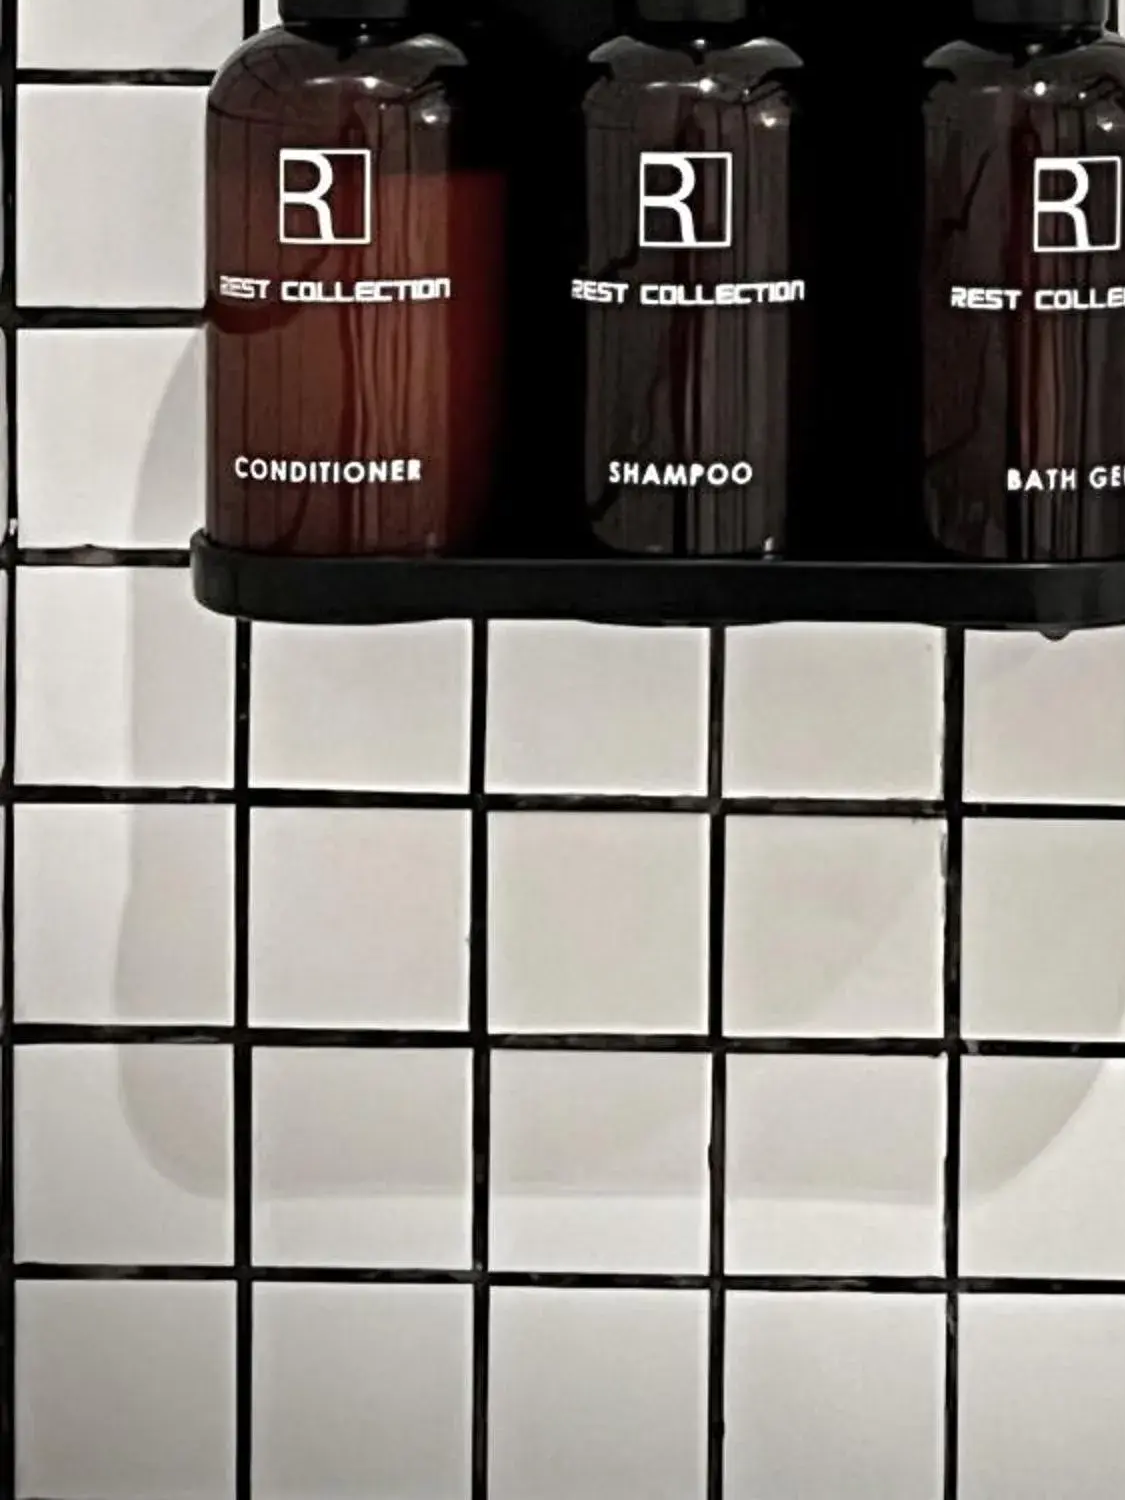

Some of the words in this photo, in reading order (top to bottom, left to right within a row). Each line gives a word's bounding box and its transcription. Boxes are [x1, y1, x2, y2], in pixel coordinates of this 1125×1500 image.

[279, 148, 337, 244] R
[639, 152, 697, 248] R
[1033, 156, 1091, 252] R
[220, 275, 271, 300] REST
[281, 278, 451, 302] COLLECTION
[571, 278, 630, 304] REST
[639, 280, 805, 306] COLLECTION
[950, 286, 1023, 311] REST
[234, 455, 423, 484] CONDITIONER
[608, 461, 753, 487] SHAMPOO
[1007, 468, 1077, 492] BATH
